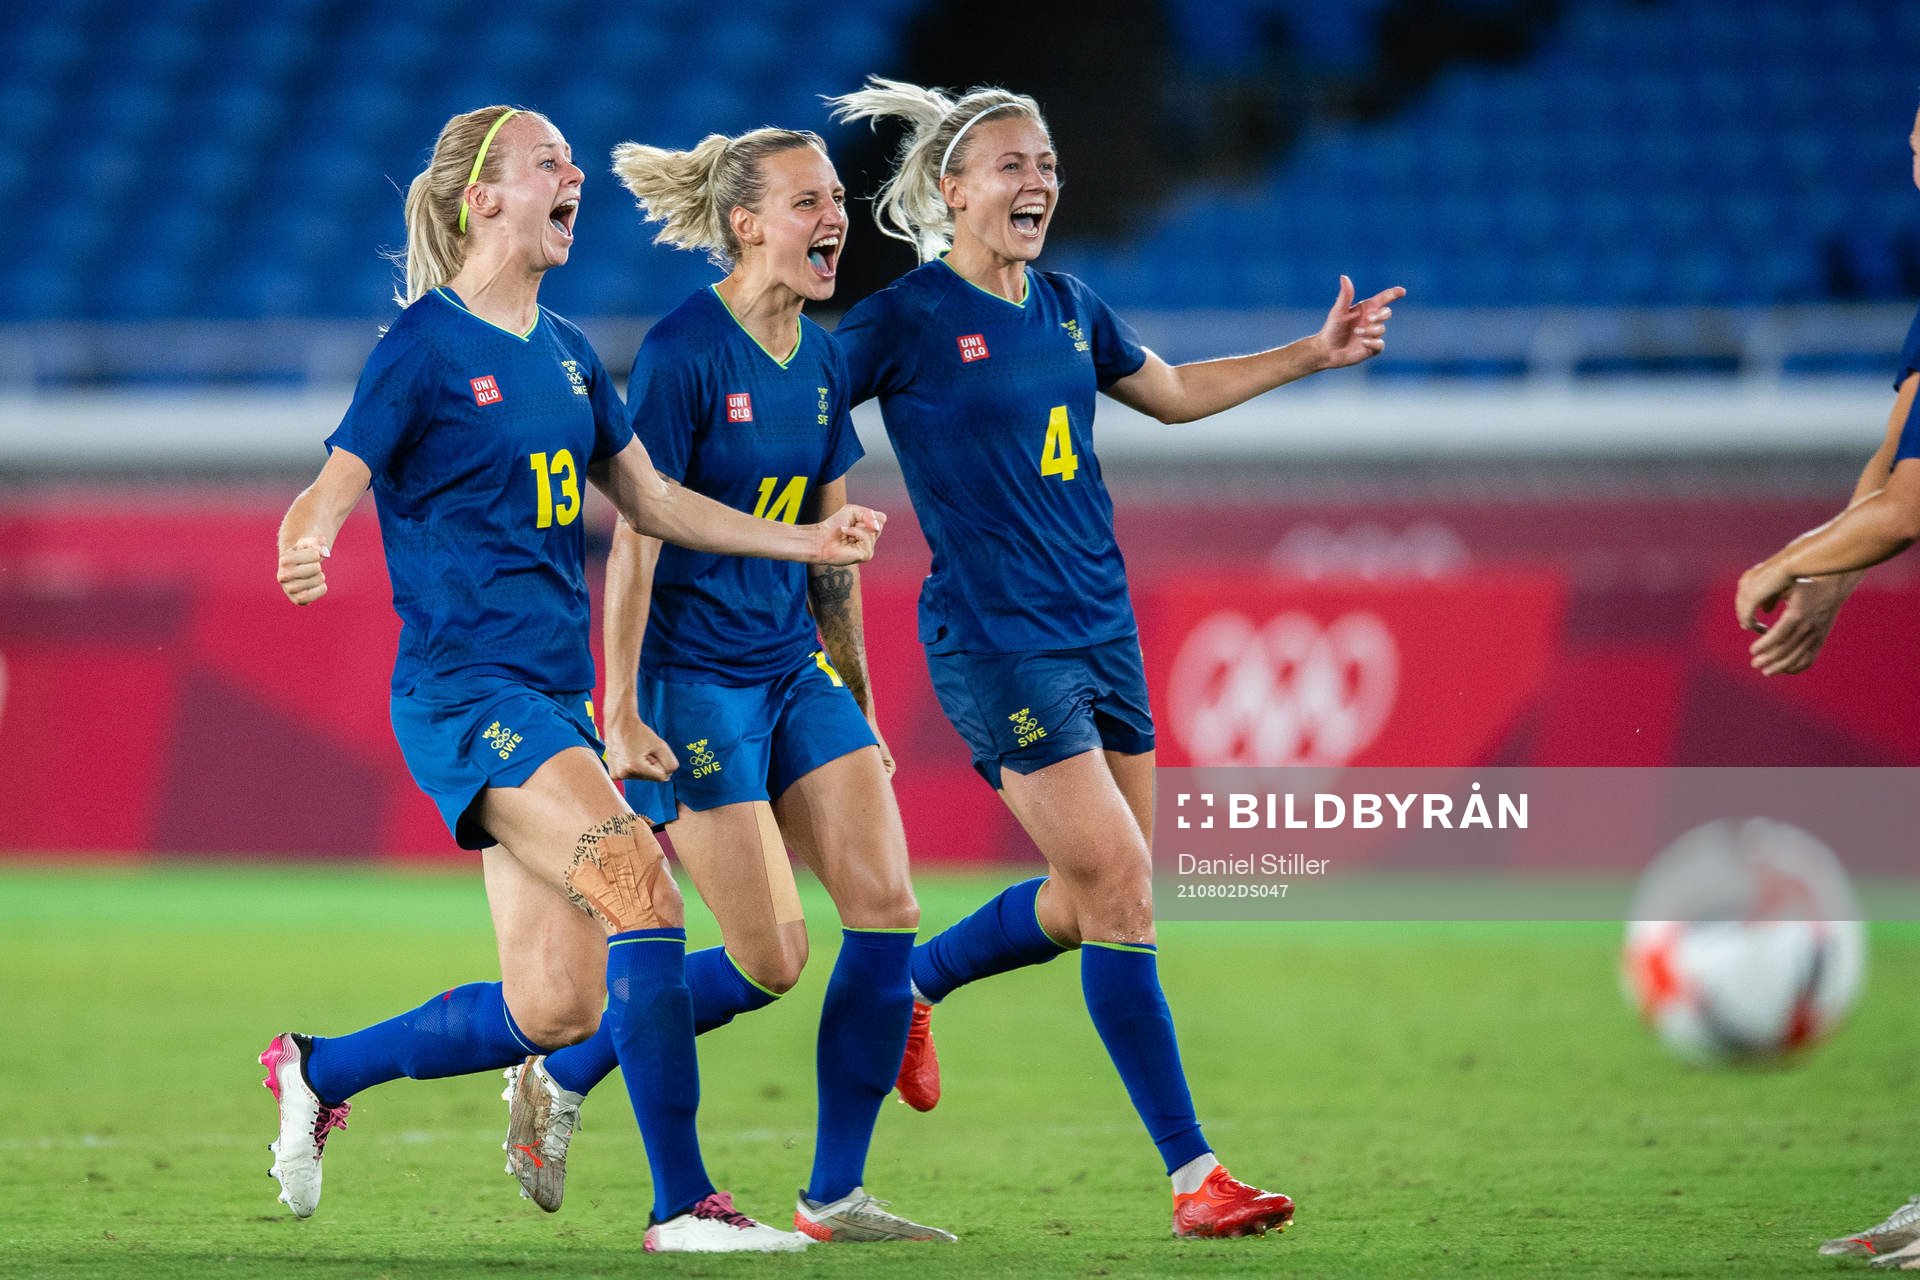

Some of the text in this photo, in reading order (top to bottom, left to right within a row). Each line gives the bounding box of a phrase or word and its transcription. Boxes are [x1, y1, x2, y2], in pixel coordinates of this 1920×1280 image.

[960, 337, 981, 348] UNI
[964, 347, 986, 360] QLO
[474, 379, 493, 391] UNI
[478, 389, 499, 402] QLO
[729, 397, 748, 408] UNI
[730, 408, 750, 420] QLO
[1040, 405, 1078, 481] 4
[530, 449, 580, 529] 13
[753, 476, 808, 525] 14
[1017, 727, 1048, 748] SWE
[498, 733, 523, 761] SWE
[692, 761, 722, 779] SWE
